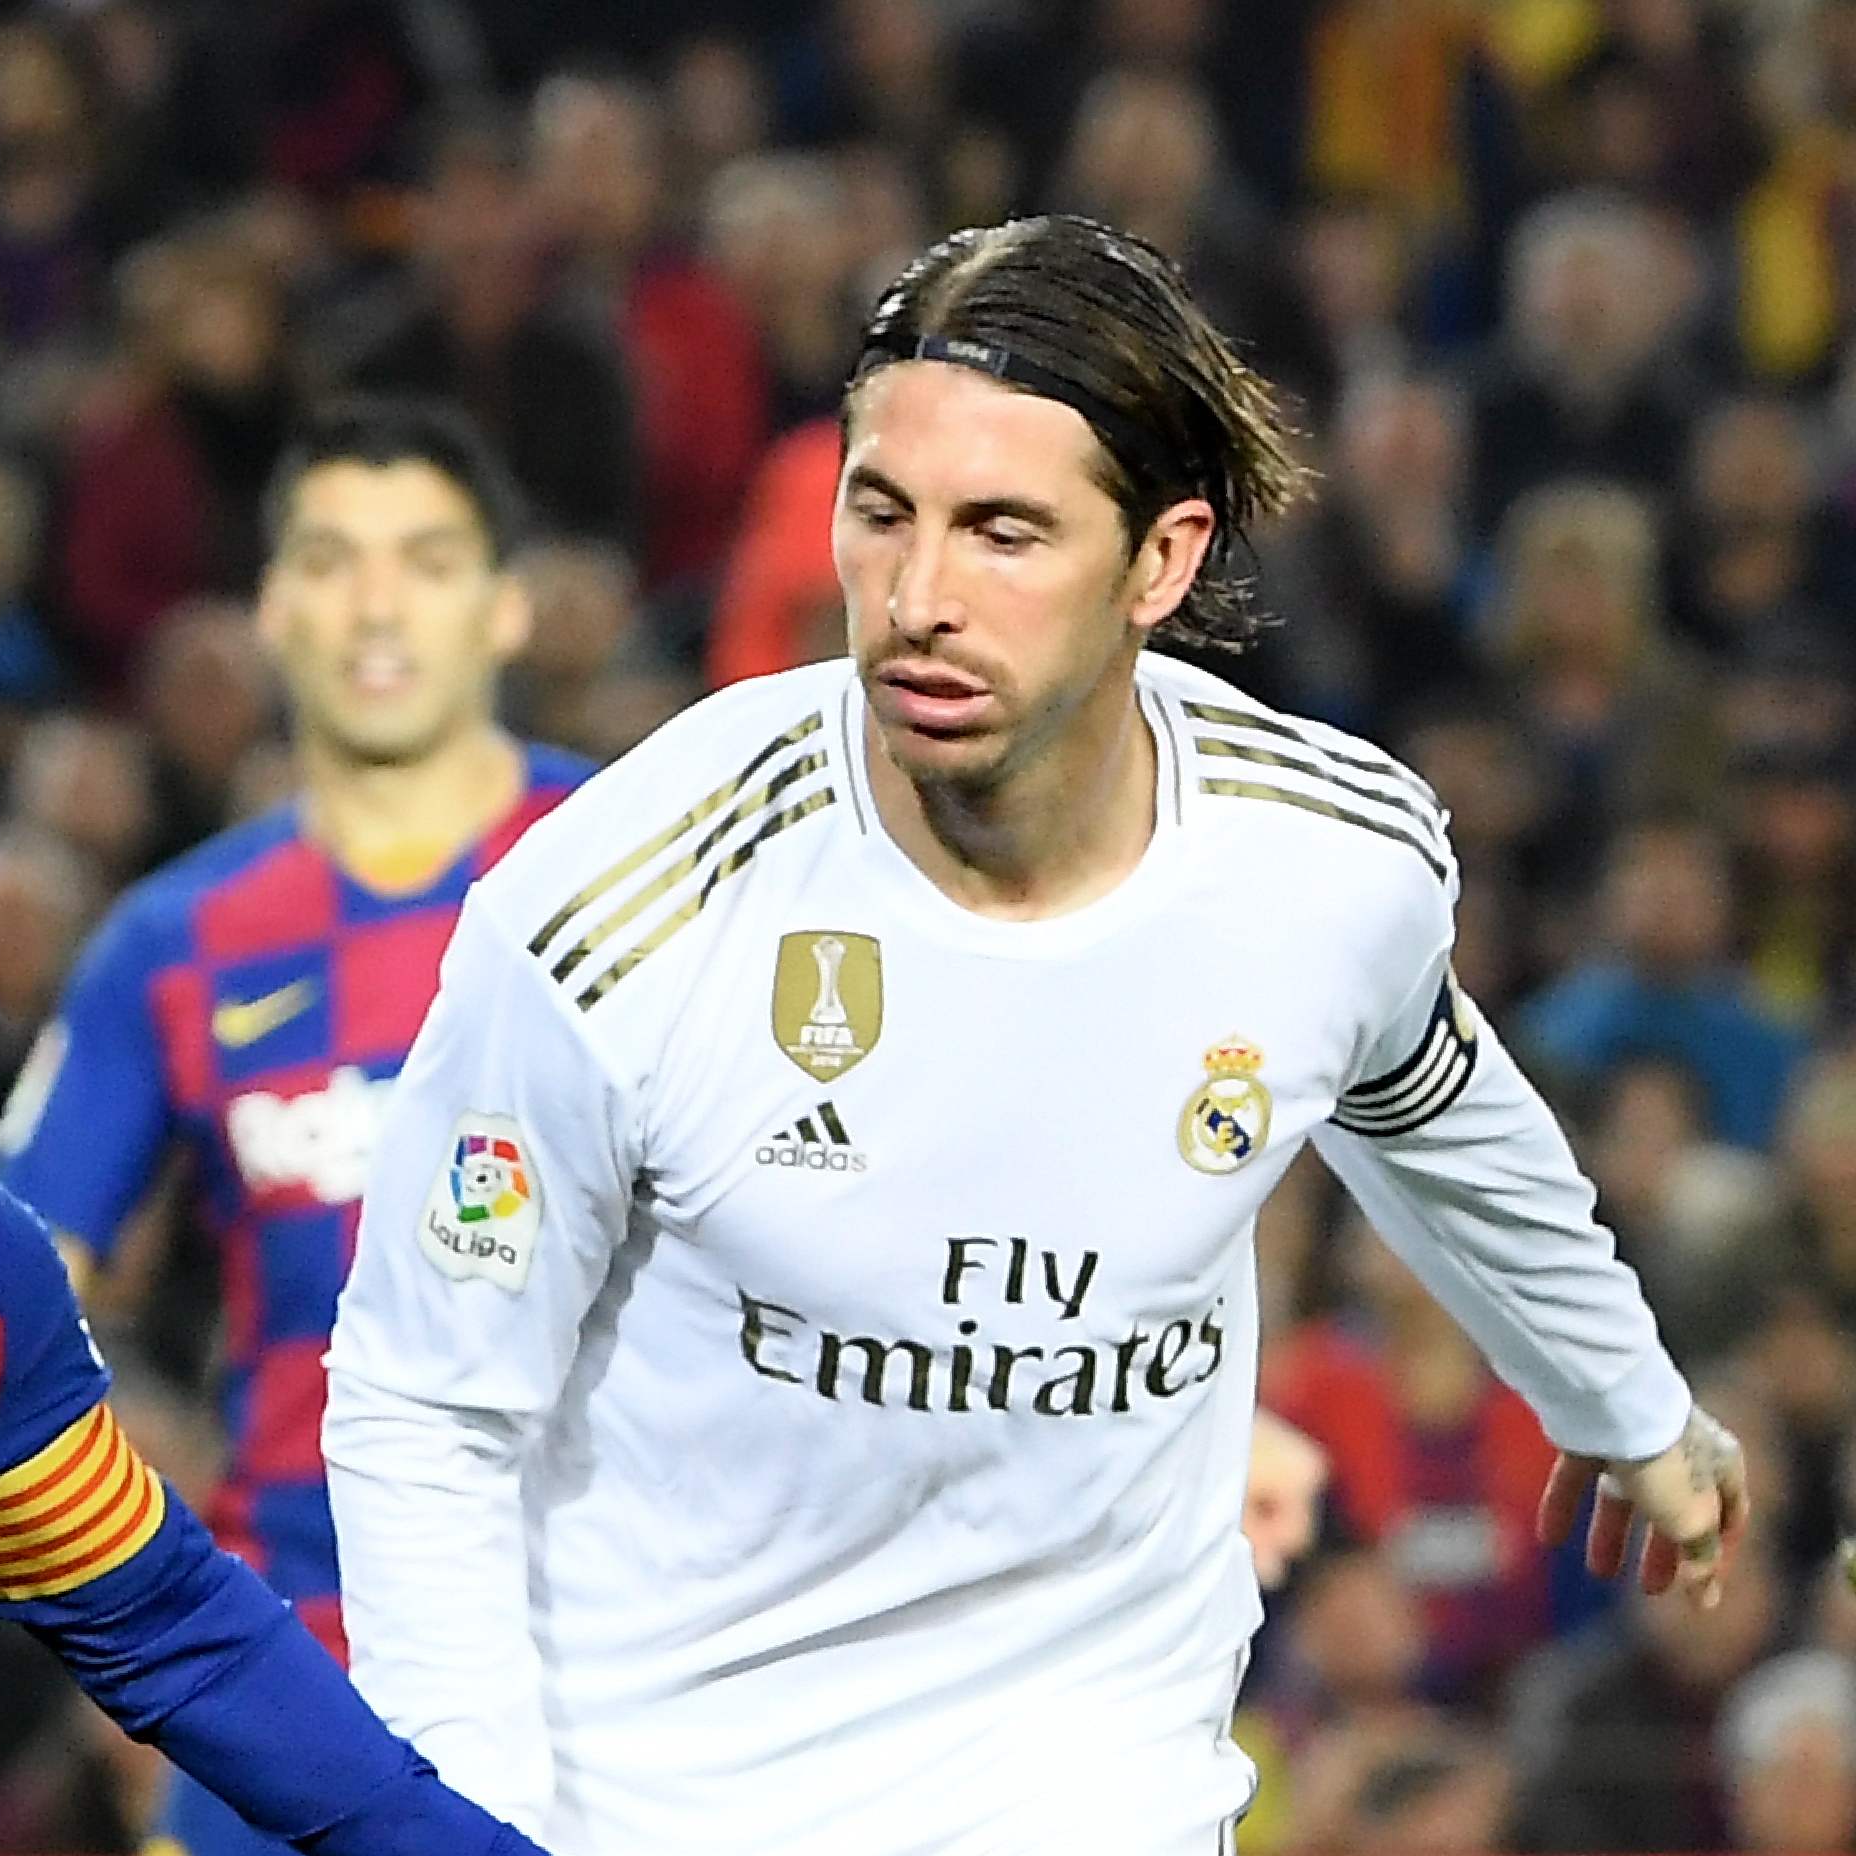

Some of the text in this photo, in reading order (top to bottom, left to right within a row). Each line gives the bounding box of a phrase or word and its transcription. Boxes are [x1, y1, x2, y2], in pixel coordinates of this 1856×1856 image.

[754, 1139, 867, 1173] adidas
[428, 1208, 517, 1265] LaLiga
[942, 1236, 1099, 1320] Fly
[737, 1282, 1225, 1417] Emirates
